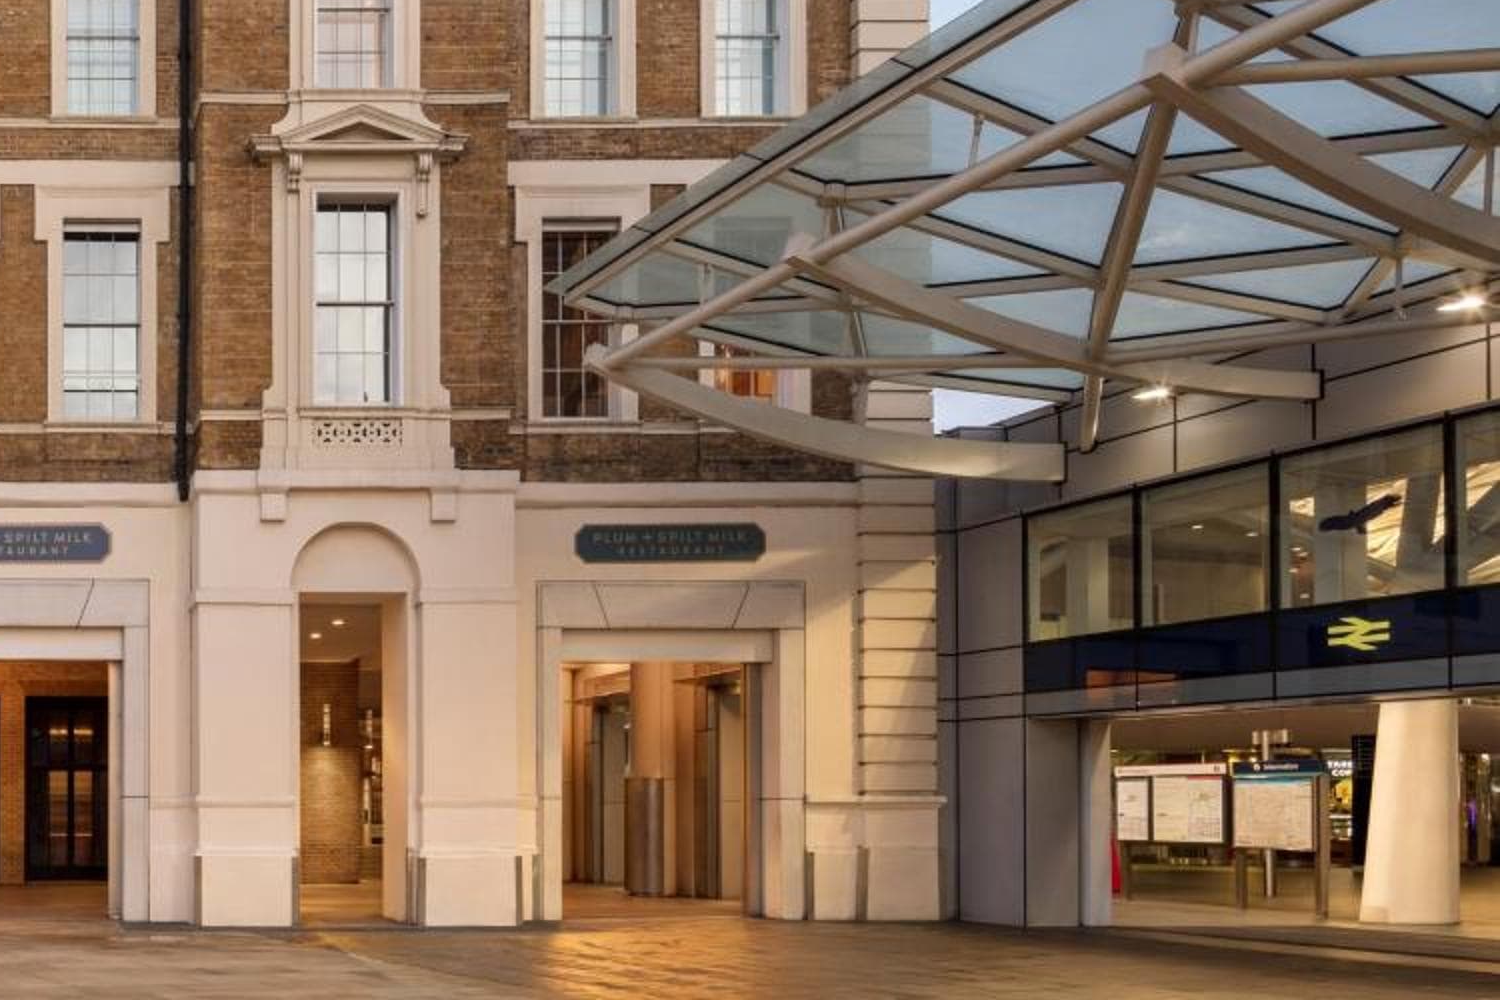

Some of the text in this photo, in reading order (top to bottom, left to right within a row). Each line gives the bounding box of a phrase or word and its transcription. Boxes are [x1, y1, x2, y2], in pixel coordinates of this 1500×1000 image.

[3, 531, 48, 544] SPILT
[53, 530, 93, 544] MILK
[592, 530, 637, 544] PLUM
[657, 530, 701, 543] SPILT
[708, 529, 748, 542] MILK
